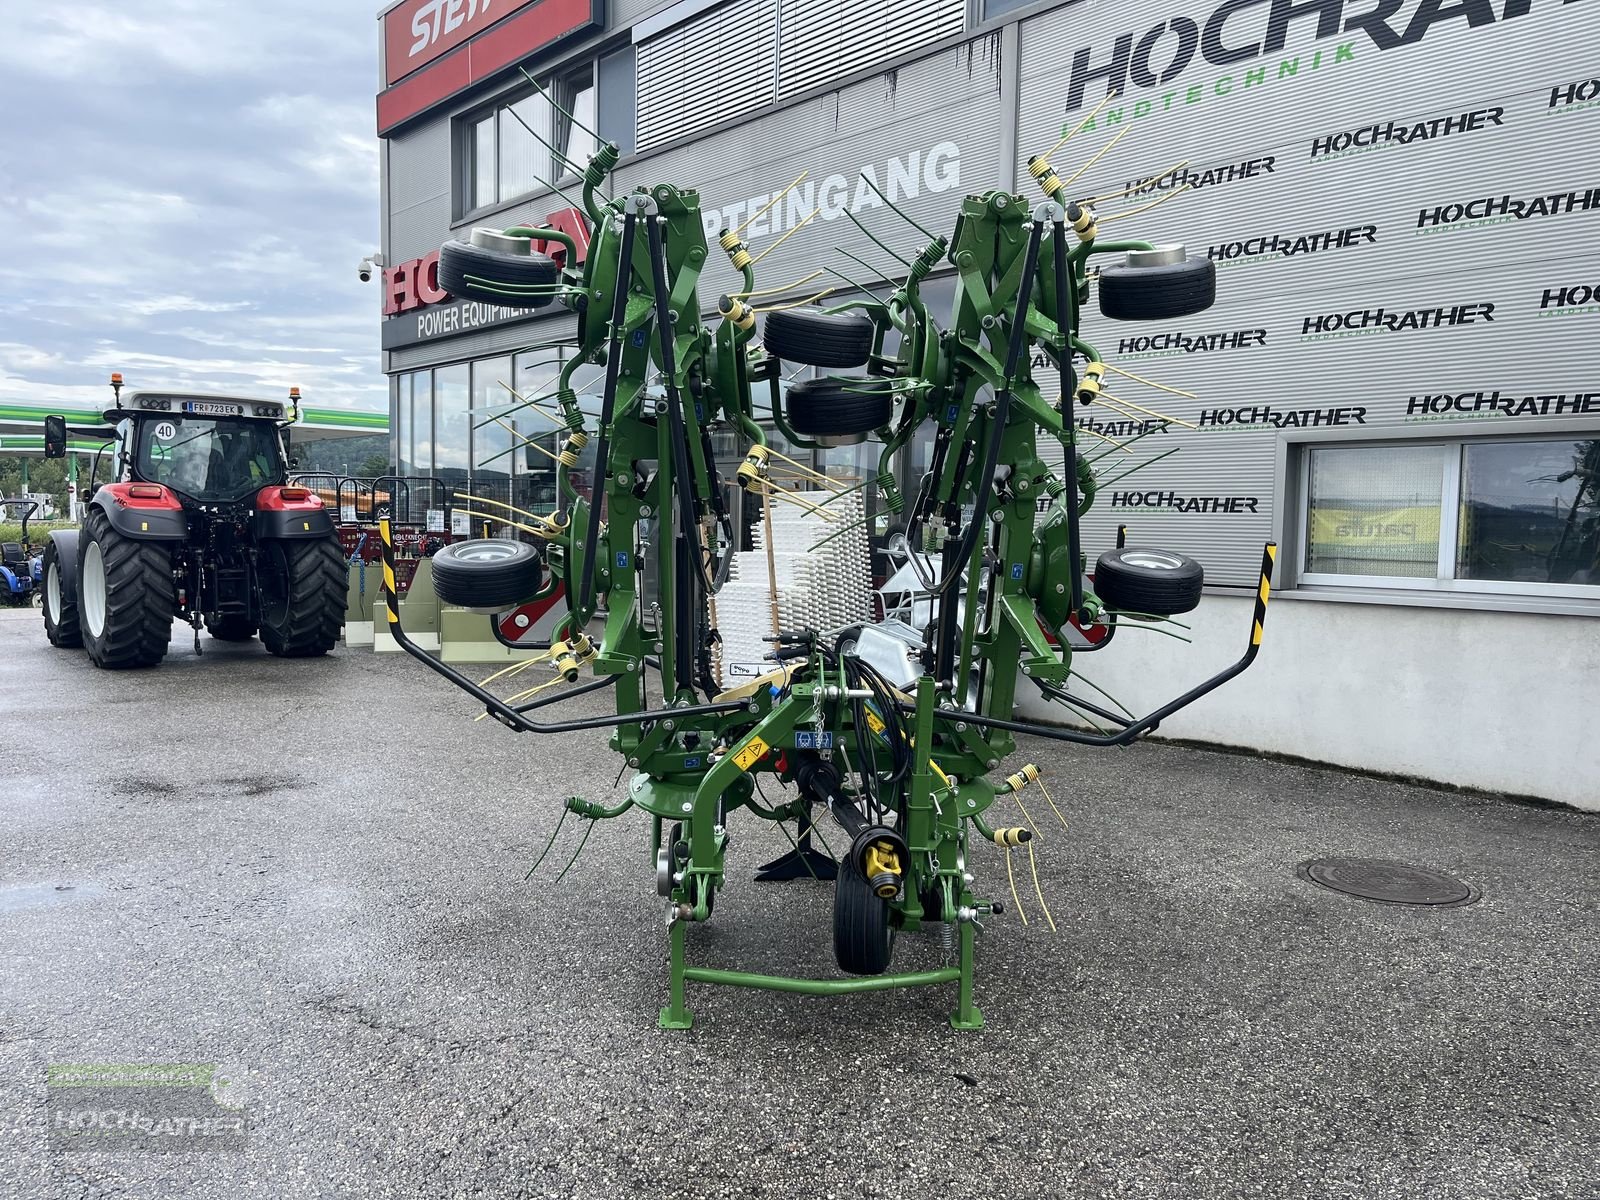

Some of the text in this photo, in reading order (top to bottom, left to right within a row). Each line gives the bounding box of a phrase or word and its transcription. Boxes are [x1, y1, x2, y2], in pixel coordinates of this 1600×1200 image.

[409, 0, 491, 57] STE
[1065, 0, 1581, 113] HOCHRA
[1060, 41, 1356, 139] LANDTECHNIK
[1311, 107, 1504, 158] HOCHRATHER
[701, 141, 960, 240] PTEINGANG
[1124, 156, 1275, 199] HOCHRATHER
[1416, 215, 1513, 236] LANDTECHNIK
[1208, 225, 1377, 261] HOCHRATHER
[418, 306, 459, 338] POWER
[1302, 303, 1495, 335] HOCHRATHER
[1118, 329, 1267, 354] HOCHRATHER
[158, 426, 172, 437] 40
[1200, 406, 1366, 428] HOCHRATHER
[1111, 491, 1258, 513] HOCHRATHER
